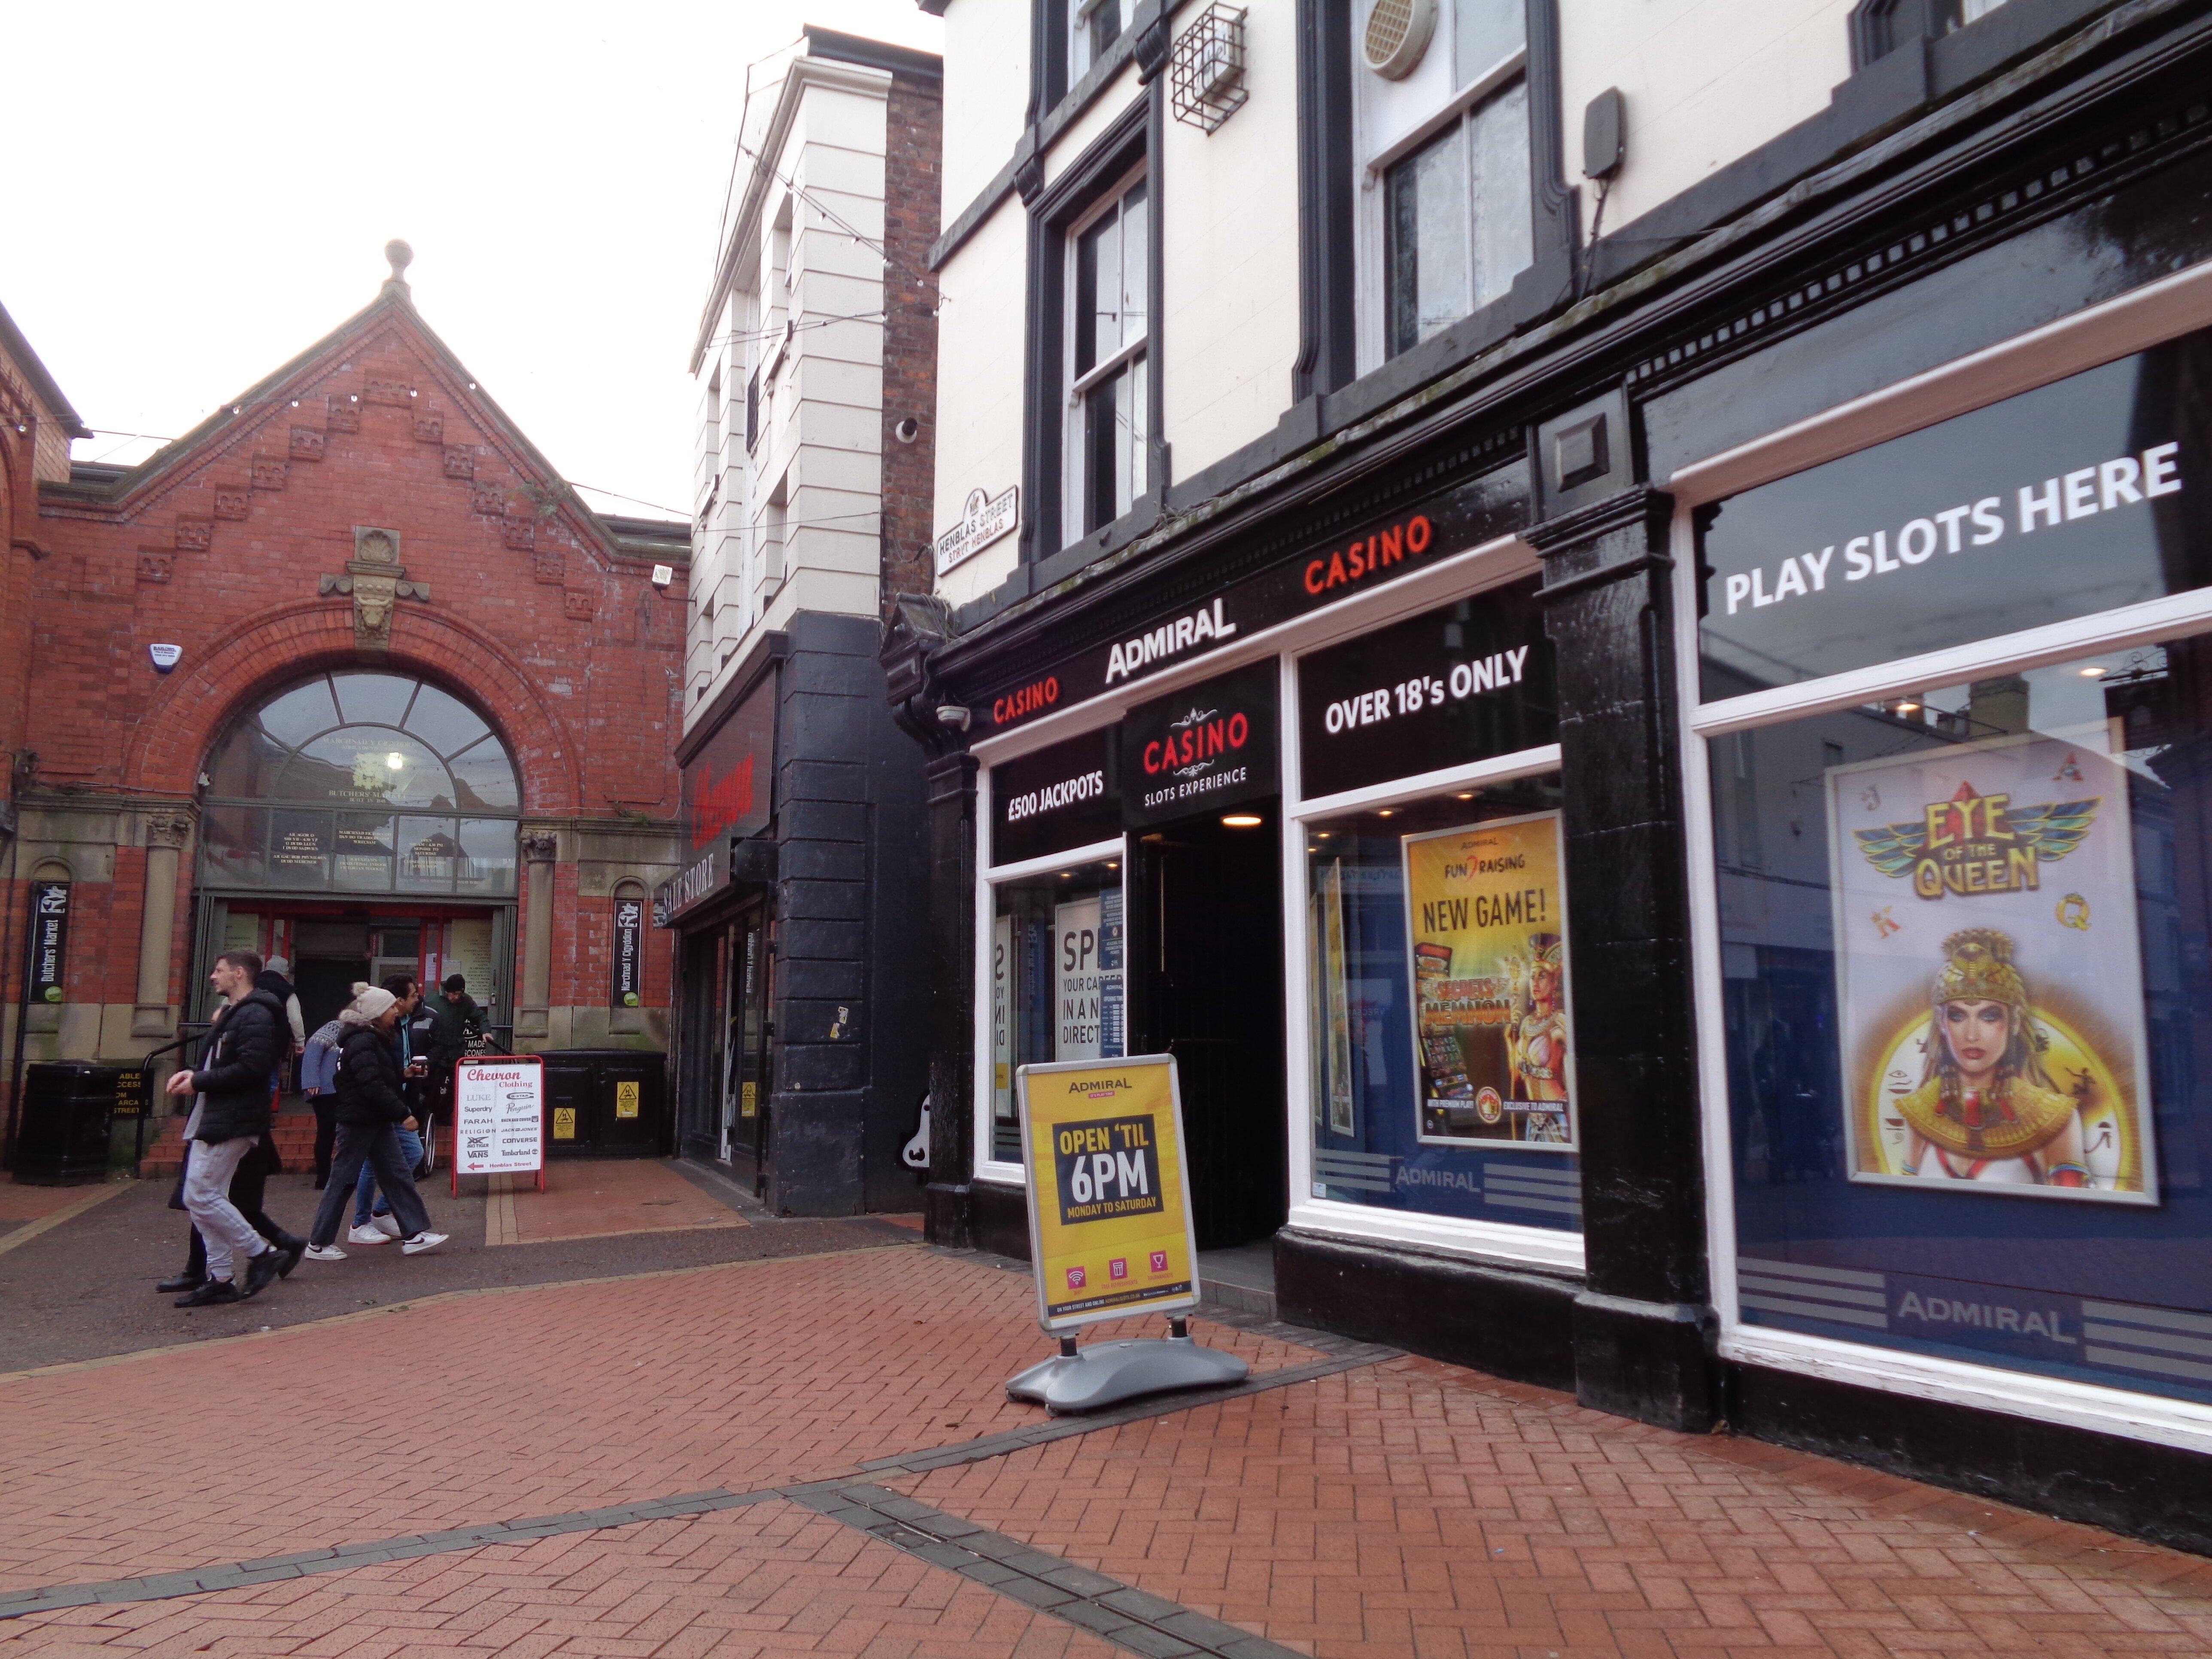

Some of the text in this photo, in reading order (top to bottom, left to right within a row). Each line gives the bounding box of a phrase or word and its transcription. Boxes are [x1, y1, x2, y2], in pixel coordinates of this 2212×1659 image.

[940, 493, 1013, 555] HENBLAS STREET
[948, 518, 1004, 563] STRYT HENBLAS
[1725, 441, 2183, 615] PLAY SLOTS HERE
[1304, 515, 1431, 595] CASINO
[1106, 597, 1236, 684] ADMIRAL
[993, 676, 1059, 723] CASINO
[1325, 645, 1528, 734] OVER 18's ONLY
[1143, 712, 1248, 773] CASINO
[1008, 770, 1103, 821] £500 JACKPOTS
[1144, 766, 1247, 807] SLOTS EXPERIENCE
[1461, 838, 1499, 850] ADMIRAL
[1926, 794, 2015, 849] EYE
[1444, 854, 1525, 879] FUN RAISING
[1913, 845, 2040, 900] QUEEN
[1944, 843, 1997, 860] OF THE
[664, 853, 714, 915] SALE STORE
[1422, 888, 1545, 933] NEW GAME!
[41, 920, 58, 981] Butchers' Market
[1063, 976, 1084, 992] YOUR
[1063, 999, 1073, 1020] IN
[1078, 998, 1086, 1019] A
[467, 1069, 521, 1081] Chevron
[1068, 1078, 1132, 1094] ADMIRAL
[506, 1103, 534, 1113] Penguin
[1060, 1127, 1110, 1155] OPEN
[1072, 1149, 1149, 1203] 6PM
[1395, 1166, 1480, 1193] ADMIRAL
[1067, 1197, 1156, 1218] MONDAY TO SATURDAY
[1898, 1290, 2078, 1344] ADMIRAL
